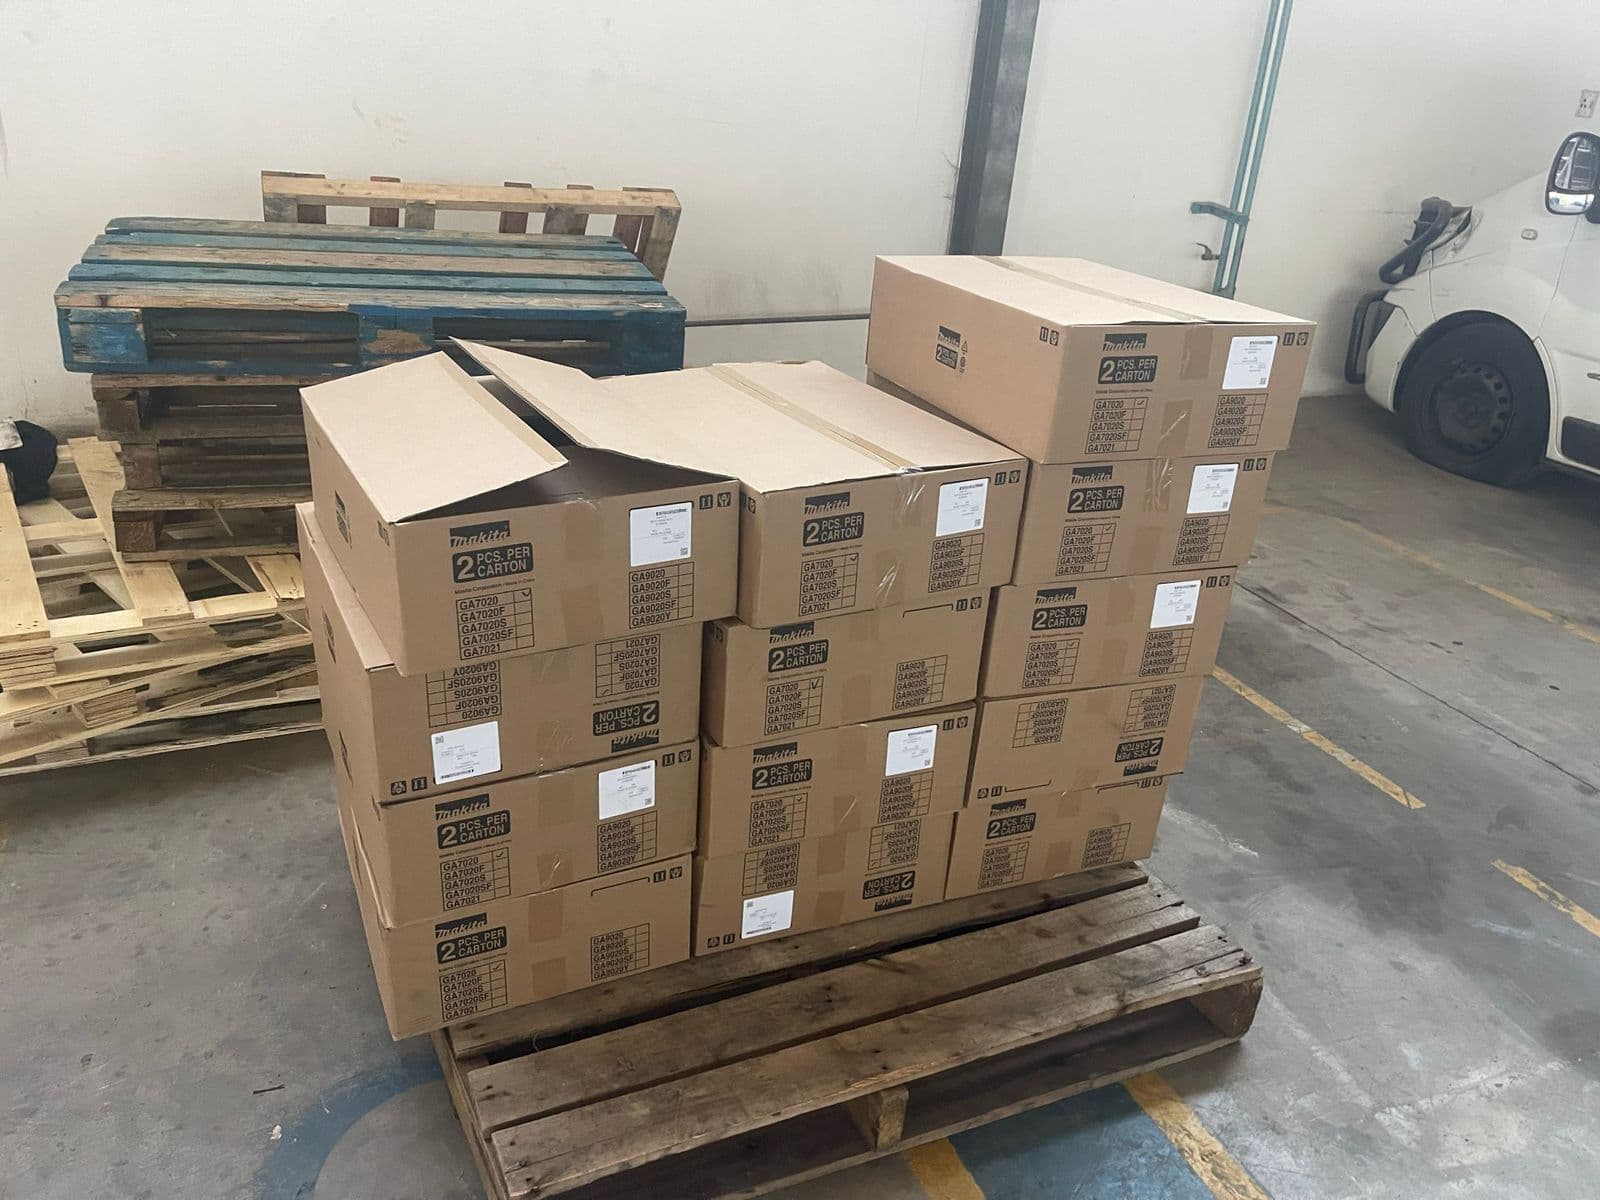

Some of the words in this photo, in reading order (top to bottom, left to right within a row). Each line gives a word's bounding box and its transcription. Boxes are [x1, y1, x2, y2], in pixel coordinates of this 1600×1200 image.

[1101, 359, 1116, 381] 2
[1138, 358, 1156, 369] PER
[1115, 369, 1152, 381] CARTON
[1095, 399, 1125, 410] GA7020
[1093, 410, 1127, 420] GA7020F
[1091, 420, 1125, 431] GA7020S
[1087, 442, 1116, 453] GA7021
[1070, 491, 1085, 511] 2
[1105, 489, 1123, 499] PER
[1084, 498, 1118, 510] CARTON
[845, 515, 863, 527] PER
[806, 521, 821, 544] 2
[822, 525, 859, 541] CARTON
[506, 545, 531, 560] PER
[934, 538, 962, 551] GA9020
[933, 547, 965, 561] GA9020F
[456, 554, 476, 580] 2
[477, 558, 527, 577] CARTON
[803, 558, 834, 572] GA7020
[932, 557, 964, 571] GA9020S
[632, 568, 666, 583] GA9020
[803, 568, 838, 583] GA7020F
[632, 578, 671, 595] GA9020F
[802, 579, 838, 594] GA7020S
[930, 578, 962, 592] GA9020Y
[459, 595, 499, 611] GA7020
[632, 589, 671, 605] GA9020S
[802, 588, 842, 604] GA7020SF
[460, 605, 506, 623] GA7020F
[632, 599, 677, 616] GA9020SF
[801, 601, 830, 615] GA7021
[1069, 607, 1086, 616] PER
[461, 617, 507, 635] GA7020S
[632, 611, 671, 627] GA9020Y
[1034, 609, 1049, 628] 2
[1048, 616, 1082, 627] CARTON
[462, 628, 514, 647] GA7020SF
[626, 635, 658, 650] GA7021
[463, 642, 501, 658] GA7021
[613, 646, 658, 662] GA7020SF
[809, 642, 827, 654] PER
[618, 657, 658, 672] GA7020S
[771, 649, 786, 670] 2
[786, 651, 824, 667] CARTON
[452, 661, 497, 678] GA9020Y
[619, 667, 657, 682] GA7020F
[446, 672, 497, 690] GA9020SF
[624, 677, 657, 692] GA7020
[769, 682, 799, 696] GA7020
[453, 683, 498, 700] GA9020S
[768, 690, 803, 705] GA7020F
[454, 694, 498, 711] GA9020F
[767, 700, 803, 715] GA7020S
[461, 705, 499, 721] GA9020
[599, 706, 640, 723] CARTON
[641, 703, 656, 724] 2
[595, 721, 615, 733] PER
[766, 720, 795, 734] GA7021
[792, 761, 810, 772] PER
[755, 768, 769, 788] 2
[770, 770, 807, 785] CARTON
[487, 813, 508, 826] PER
[600, 818, 631, 834] GA9020
[441, 824, 460, 846] 2
[461, 822, 505, 842] CARTON
[600, 826, 636, 844] GA9020F
[600, 835, 636, 853] GA9020S
[443, 855, 479, 872] GA7020
[600, 853, 636, 872] GA9020Y
[443, 864, 485, 881] GA7020F
[444, 873, 486, 891] GA7020S
[445, 881, 493, 900] GA7020SF
[446, 894, 480, 910] GA7021
[484, 929, 504, 941] PER
[440, 941, 458, 961] 2
[458, 937, 501, 957] CARTON
[442, 968, 477, 985] GA7020
[443, 976, 483, 994] GA7020F
[444, 984, 484, 1003] GA7020S
[445, 1004, 478, 1020] GA7021
